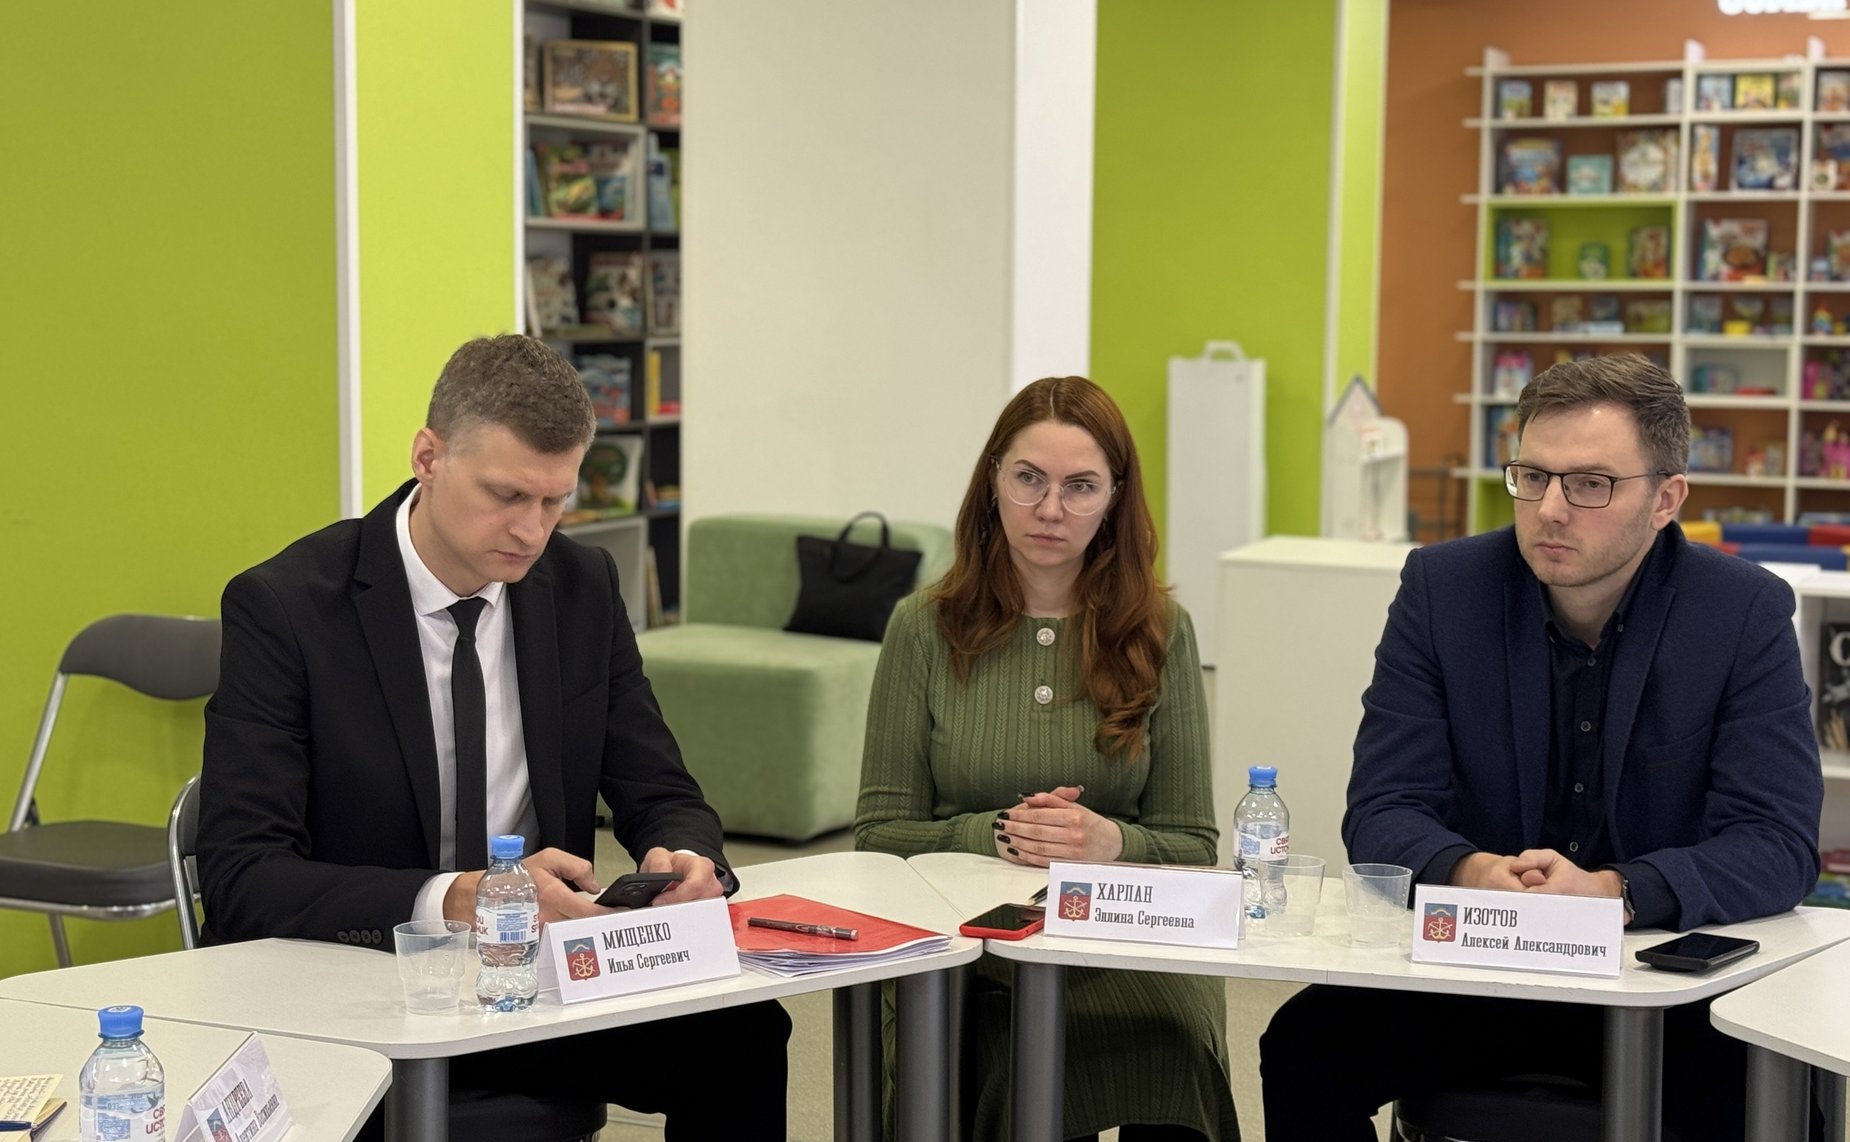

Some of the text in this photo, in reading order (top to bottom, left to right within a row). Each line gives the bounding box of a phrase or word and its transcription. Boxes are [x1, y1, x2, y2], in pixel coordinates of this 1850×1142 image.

[1096, 883, 1154, 903] ХАРЛАН
[1094, 907, 1195, 928] Эллина Сергеевна
[1463, 906, 1518, 928] ИЗОТОВ
[601, 921, 672, 951] МИЩЕНКО
[1461, 932, 1608, 958] Алексей Александрович
[607, 950, 691, 974] Илья Сергеевич
[221, 1078, 254, 1124] АНДРЕЕВА
